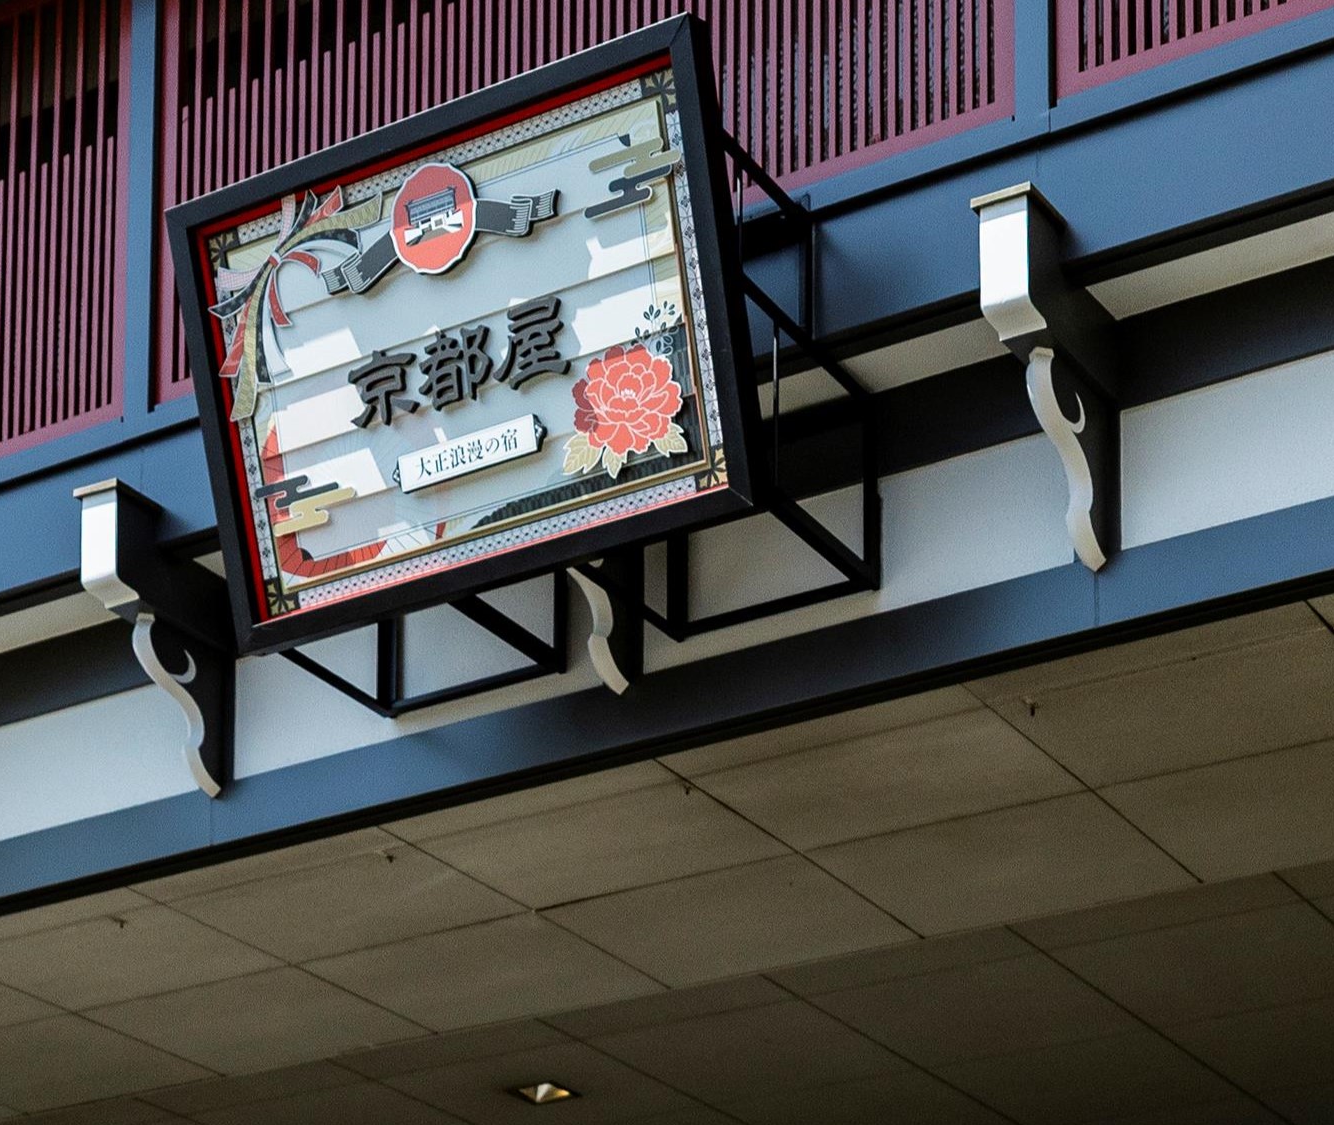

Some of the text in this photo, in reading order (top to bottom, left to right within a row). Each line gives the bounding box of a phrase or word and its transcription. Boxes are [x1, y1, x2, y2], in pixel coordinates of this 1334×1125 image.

[348, 295, 571, 428] 京都屋
[416, 428, 518, 480] 大正浪漫の宿
